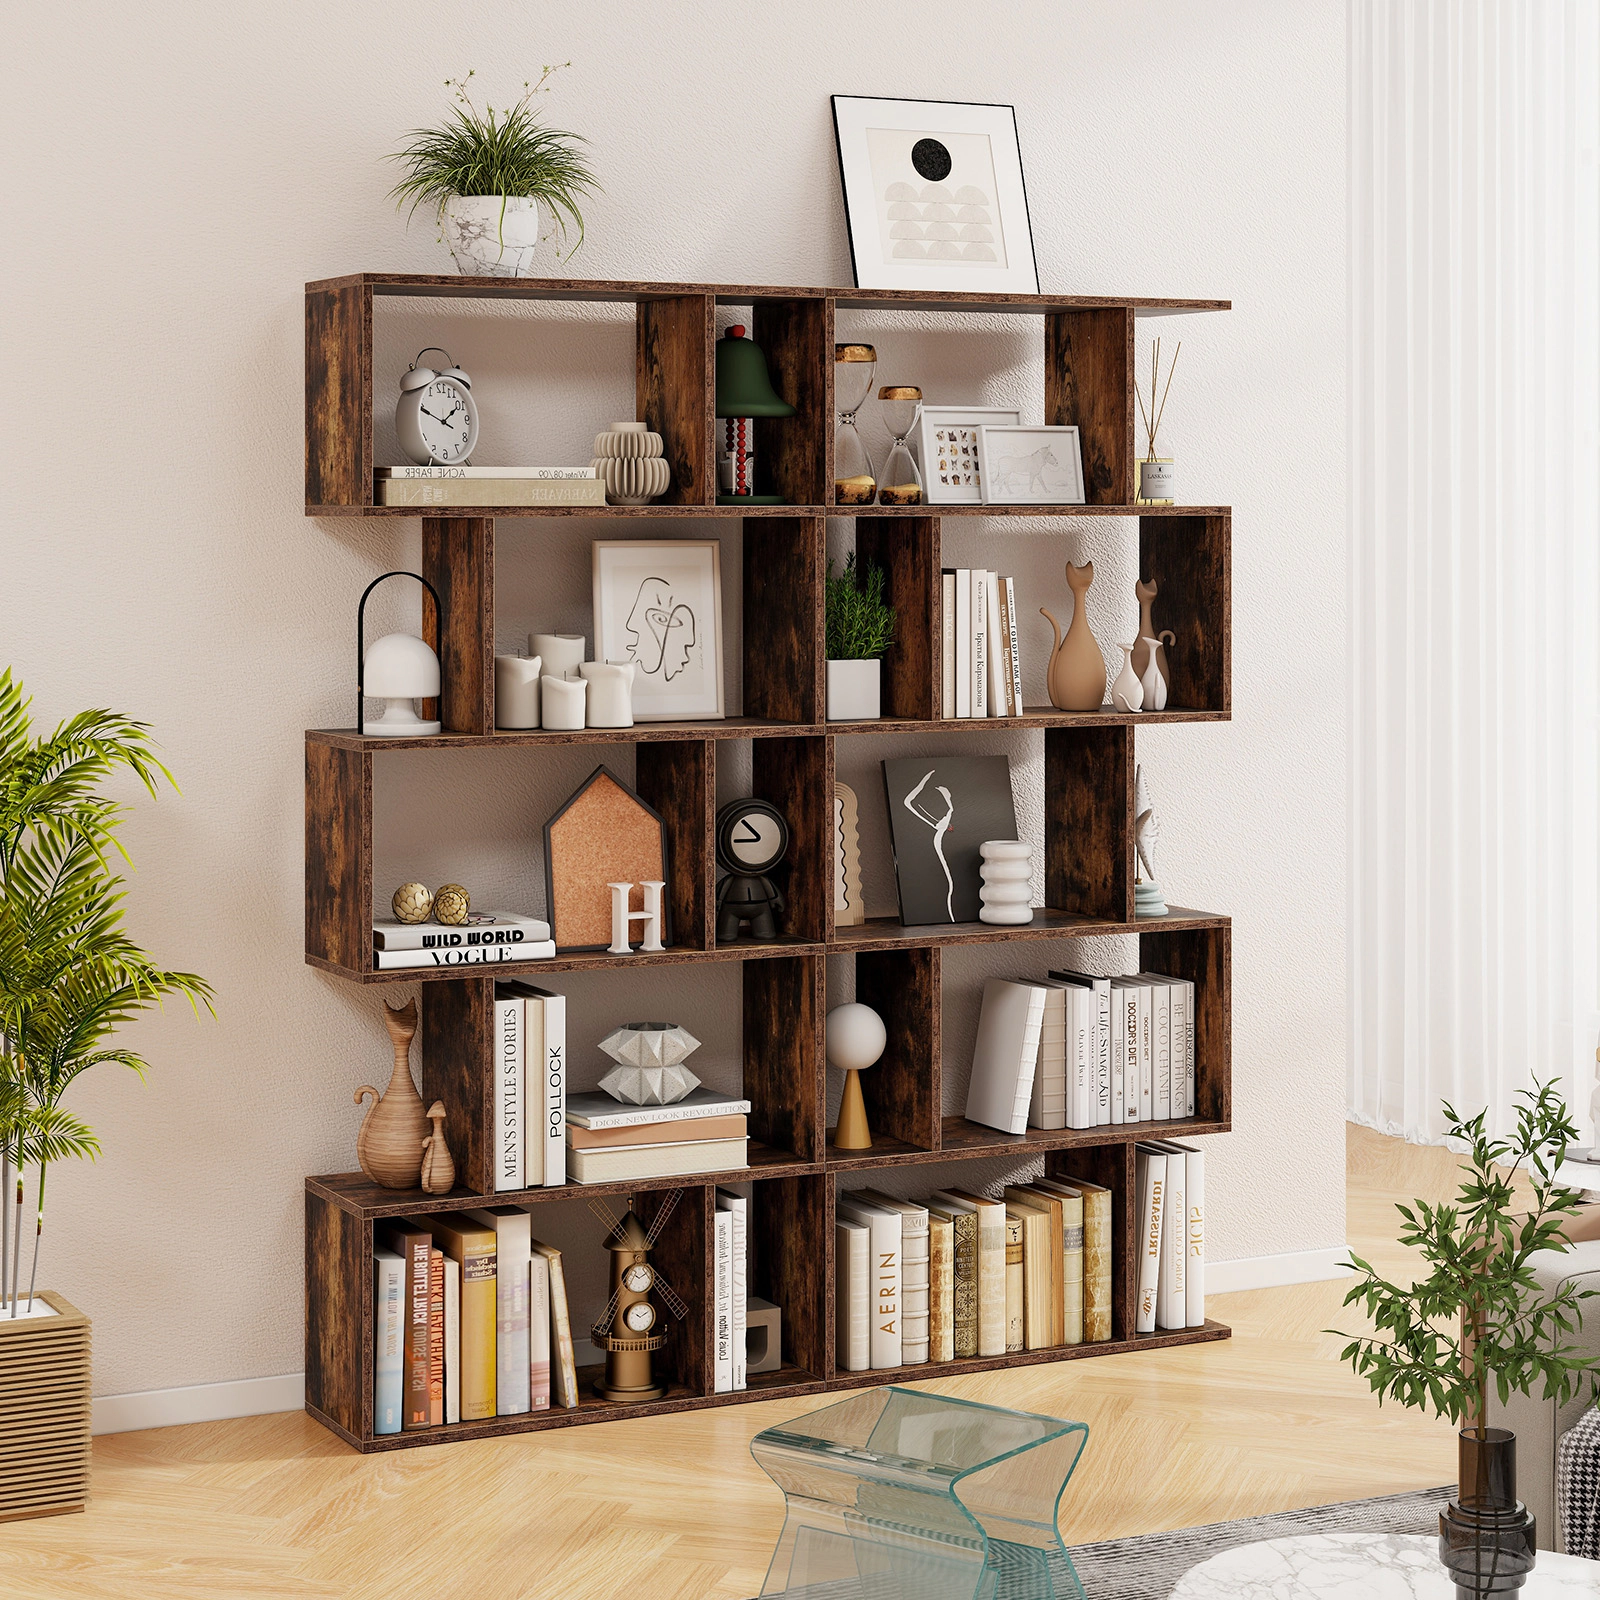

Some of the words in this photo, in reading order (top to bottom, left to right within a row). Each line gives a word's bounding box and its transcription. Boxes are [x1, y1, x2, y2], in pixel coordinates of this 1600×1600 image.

[1010, 625, 1019, 662] ГОВОРИ
[1013, 664, 1021, 679] КАК
[422, 933, 462, 948] WILD
[467, 929, 524, 944] WORLD
[431, 947, 513, 966] VOGUE
[1174, 1003, 1184, 1018] BE
[503, 1008, 517, 1074] STORIES
[1174, 1023, 1185, 1053] TWO
[1128, 1047, 1137, 1067] DIET
[549, 1046, 562, 1138] POLLOCK
[1158, 1049, 1169, 1104] CHANEL
[503, 1078, 517, 1126] STYLE
[626, 1115, 647, 1124] NEW
[652, 1112, 680, 1121] LOOK
[682, 1104, 747, 1118] REVOLUTION
[503, 1131, 517, 1178] MEN'S
[879, 1251, 897, 1335] AERIN
